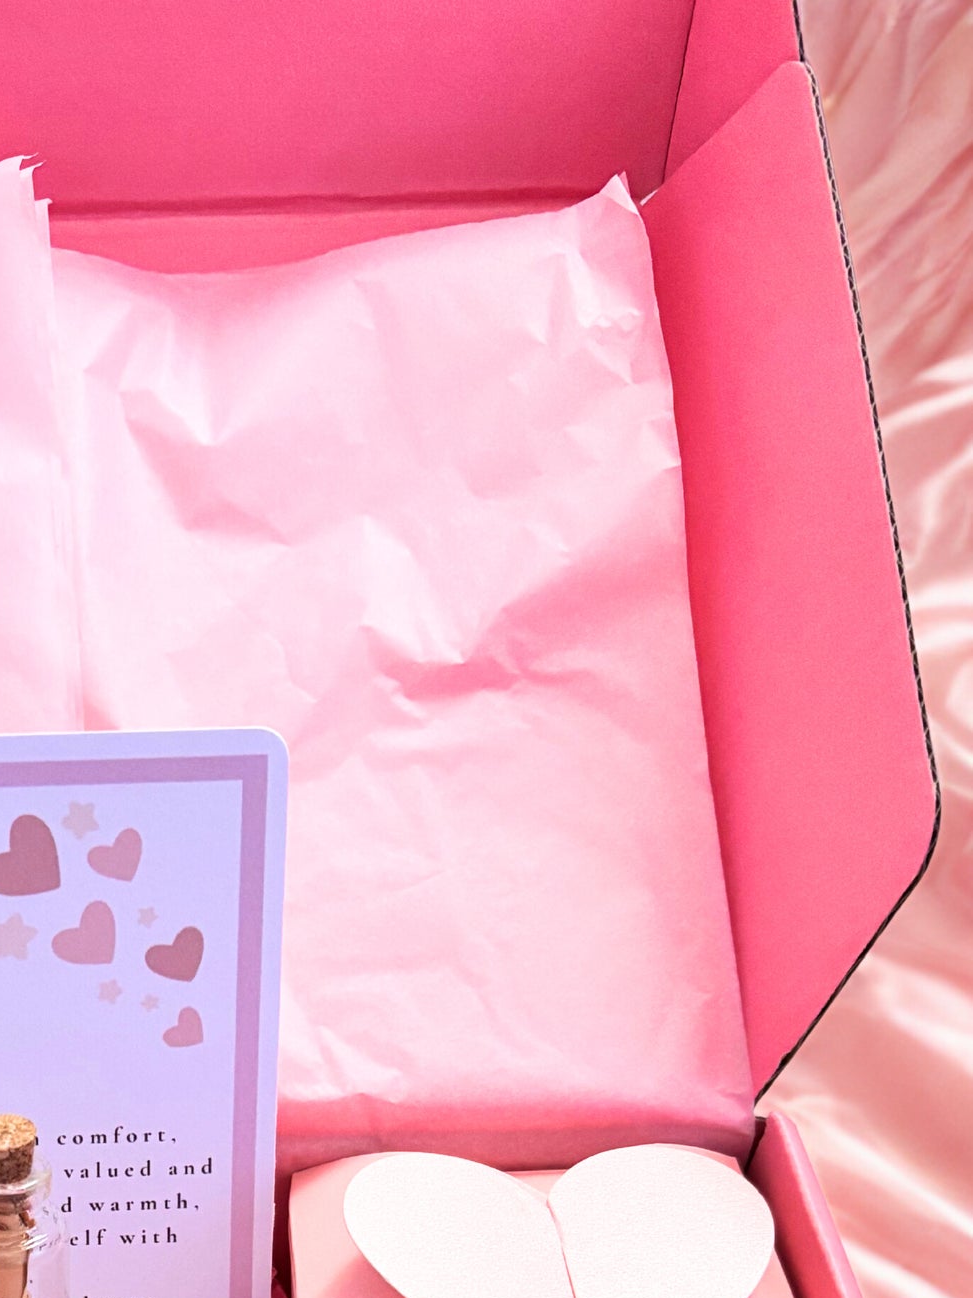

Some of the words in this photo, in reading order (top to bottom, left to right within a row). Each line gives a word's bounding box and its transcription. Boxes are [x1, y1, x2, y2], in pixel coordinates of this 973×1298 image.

[56, 1125, 177, 1146] comfort,
[63, 1159, 151, 1179] valued
[168, 1156, 213, 1176] and
[88, 1192, 199, 1212] warmth,
[119, 1226, 177, 1245] with
